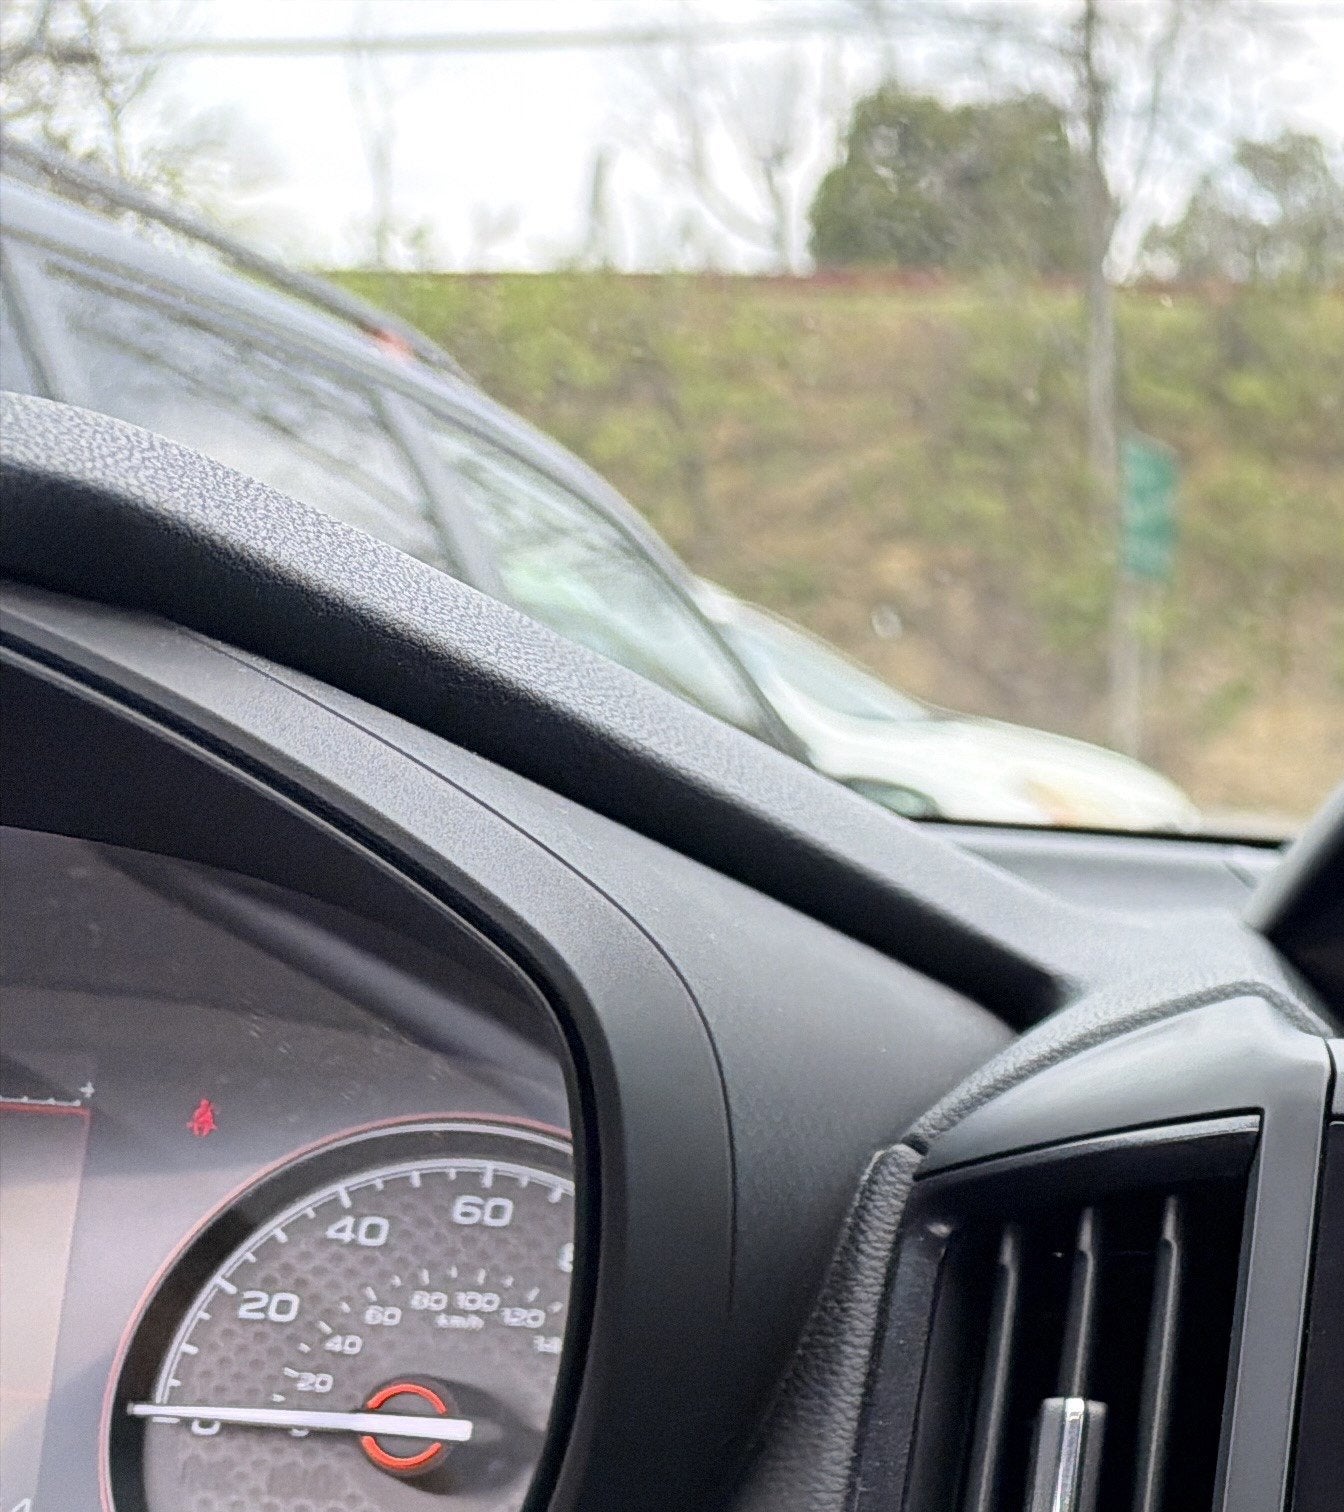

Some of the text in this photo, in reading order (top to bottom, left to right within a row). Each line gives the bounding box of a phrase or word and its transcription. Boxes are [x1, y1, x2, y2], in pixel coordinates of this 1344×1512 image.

[452, 1195, 513, 1227] 60
[326, 1216, 389, 1246] 40
[238, 1291, 300, 1323] 20
[325, 1335, 362, 1355] 40
[297, 1371, 333, 1393] 20
